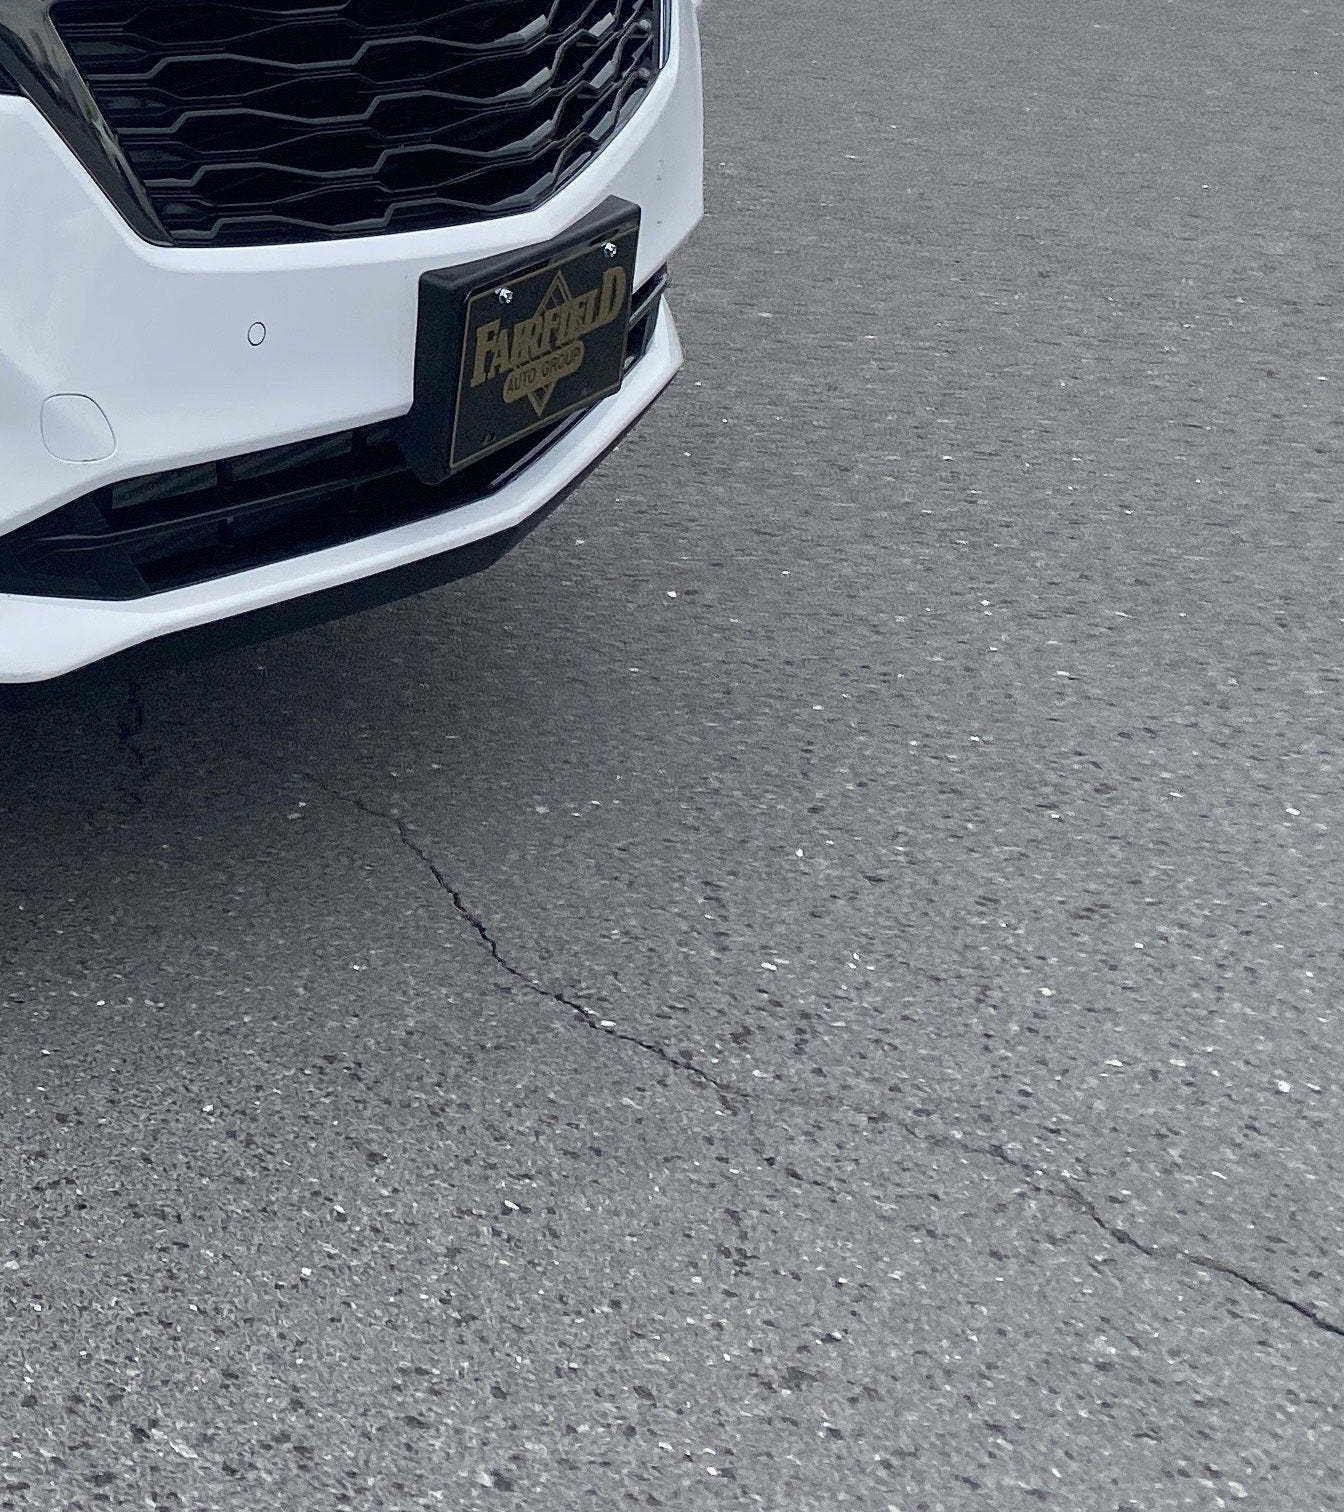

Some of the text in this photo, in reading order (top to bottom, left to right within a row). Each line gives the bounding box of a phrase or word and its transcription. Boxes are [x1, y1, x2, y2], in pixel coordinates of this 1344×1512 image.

[469, 265, 627, 388] FAIRFIELD
[508, 345, 582, 394] AUTO GROUP
